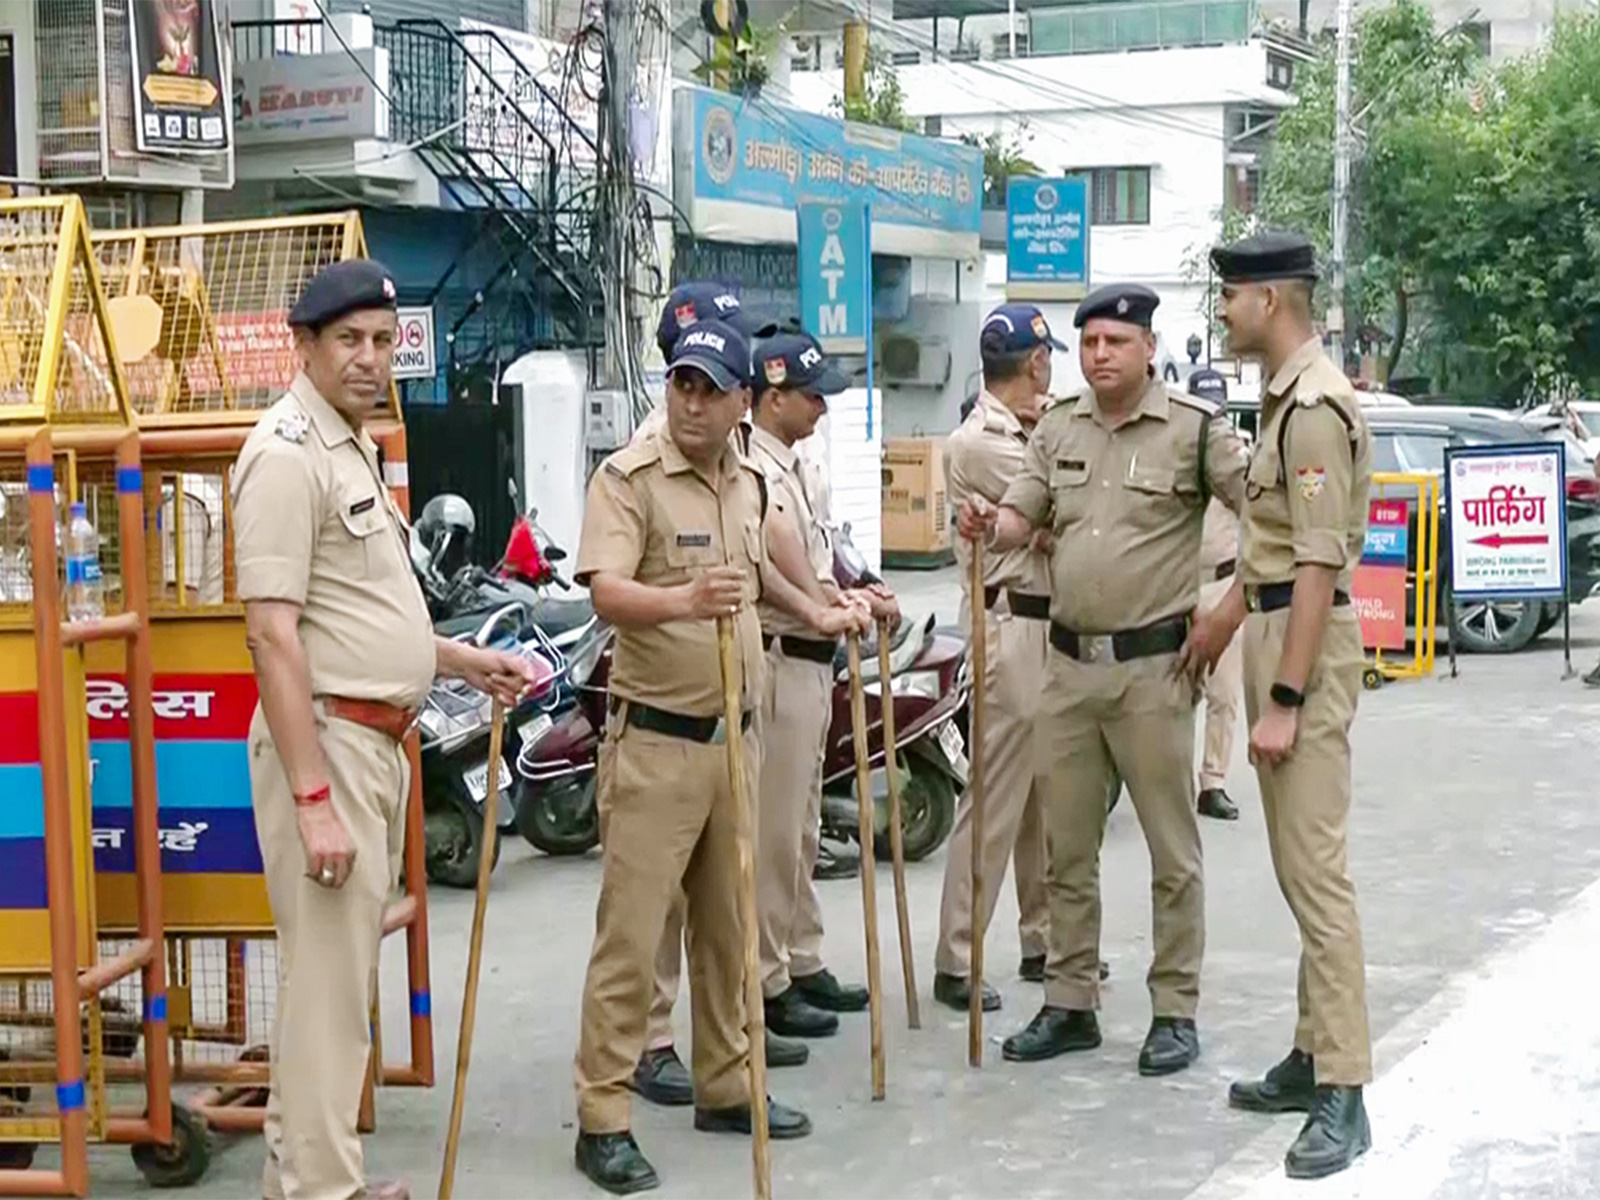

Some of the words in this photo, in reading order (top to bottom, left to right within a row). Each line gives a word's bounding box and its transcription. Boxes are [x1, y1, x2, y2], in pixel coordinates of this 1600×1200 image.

[818, 234, 848, 336] ATM
[683, 330, 726, 353] POLICE
[393, 350, 425, 367] KING
[1462, 485, 1547, 526] पार्किंग
